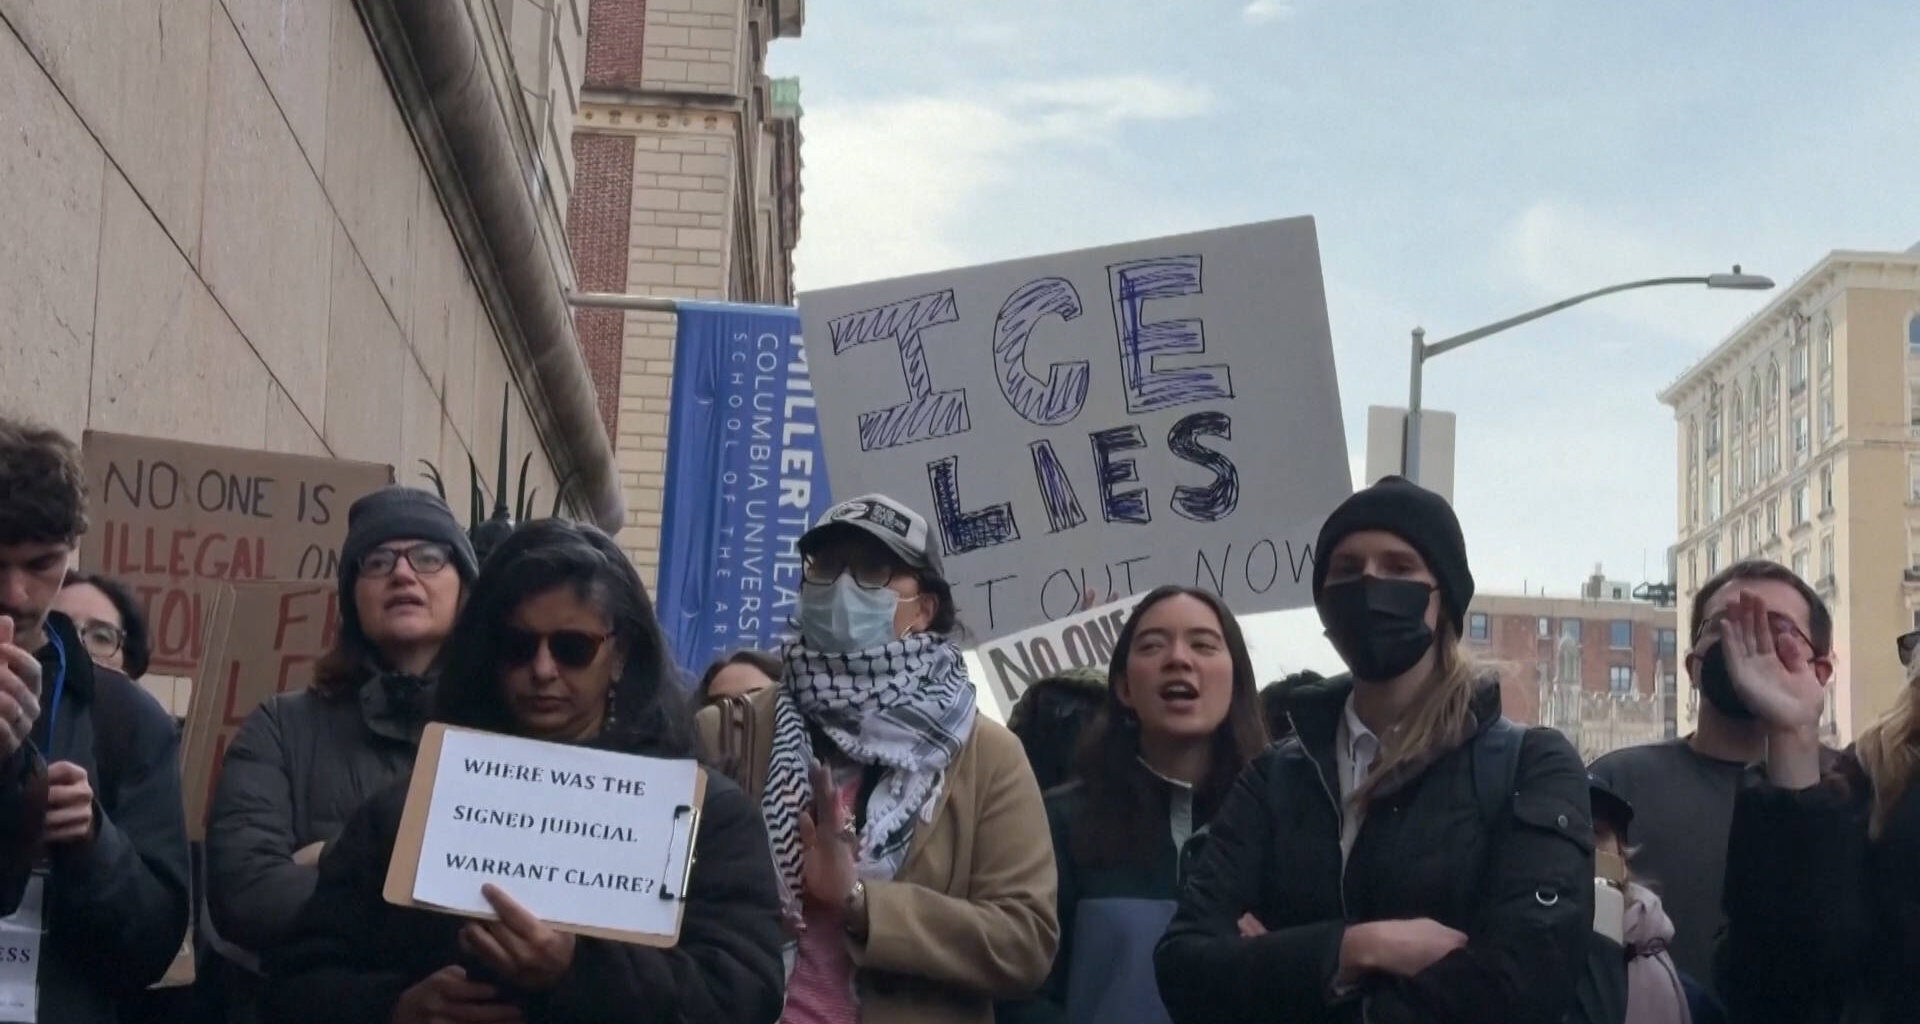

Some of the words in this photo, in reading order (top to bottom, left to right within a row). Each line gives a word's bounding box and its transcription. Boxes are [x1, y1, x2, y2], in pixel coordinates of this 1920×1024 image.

[828, 254, 1235, 451] ICE
[724, 332, 748, 449] SCHOOL
[747, 333, 778, 490] COLUMBIA
[104, 459, 178, 510] NO
[197, 469, 275, 519] ONE
[297, 482, 336, 525] IS
[723, 471, 738, 503] OF
[927, 411, 1240, 556] LIES
[104, 521, 276, 581] ILLEGAL
[717, 528, 734, 578] THE
[1040, 556, 1150, 621] OUT
[1194, 539, 1317, 597] NOW
[988, 637, 1062, 701] NO
[464, 757, 544, 783] WHERE
[550, 769, 596, 790] WAS
[602, 776, 647, 797] THE
[452, 804, 535, 829] SIGNED
[540, 817, 638, 843] JUDICIAL
[446, 853, 559, 883] WARRANT
[564, 868, 655, 895] CLAIRE?
